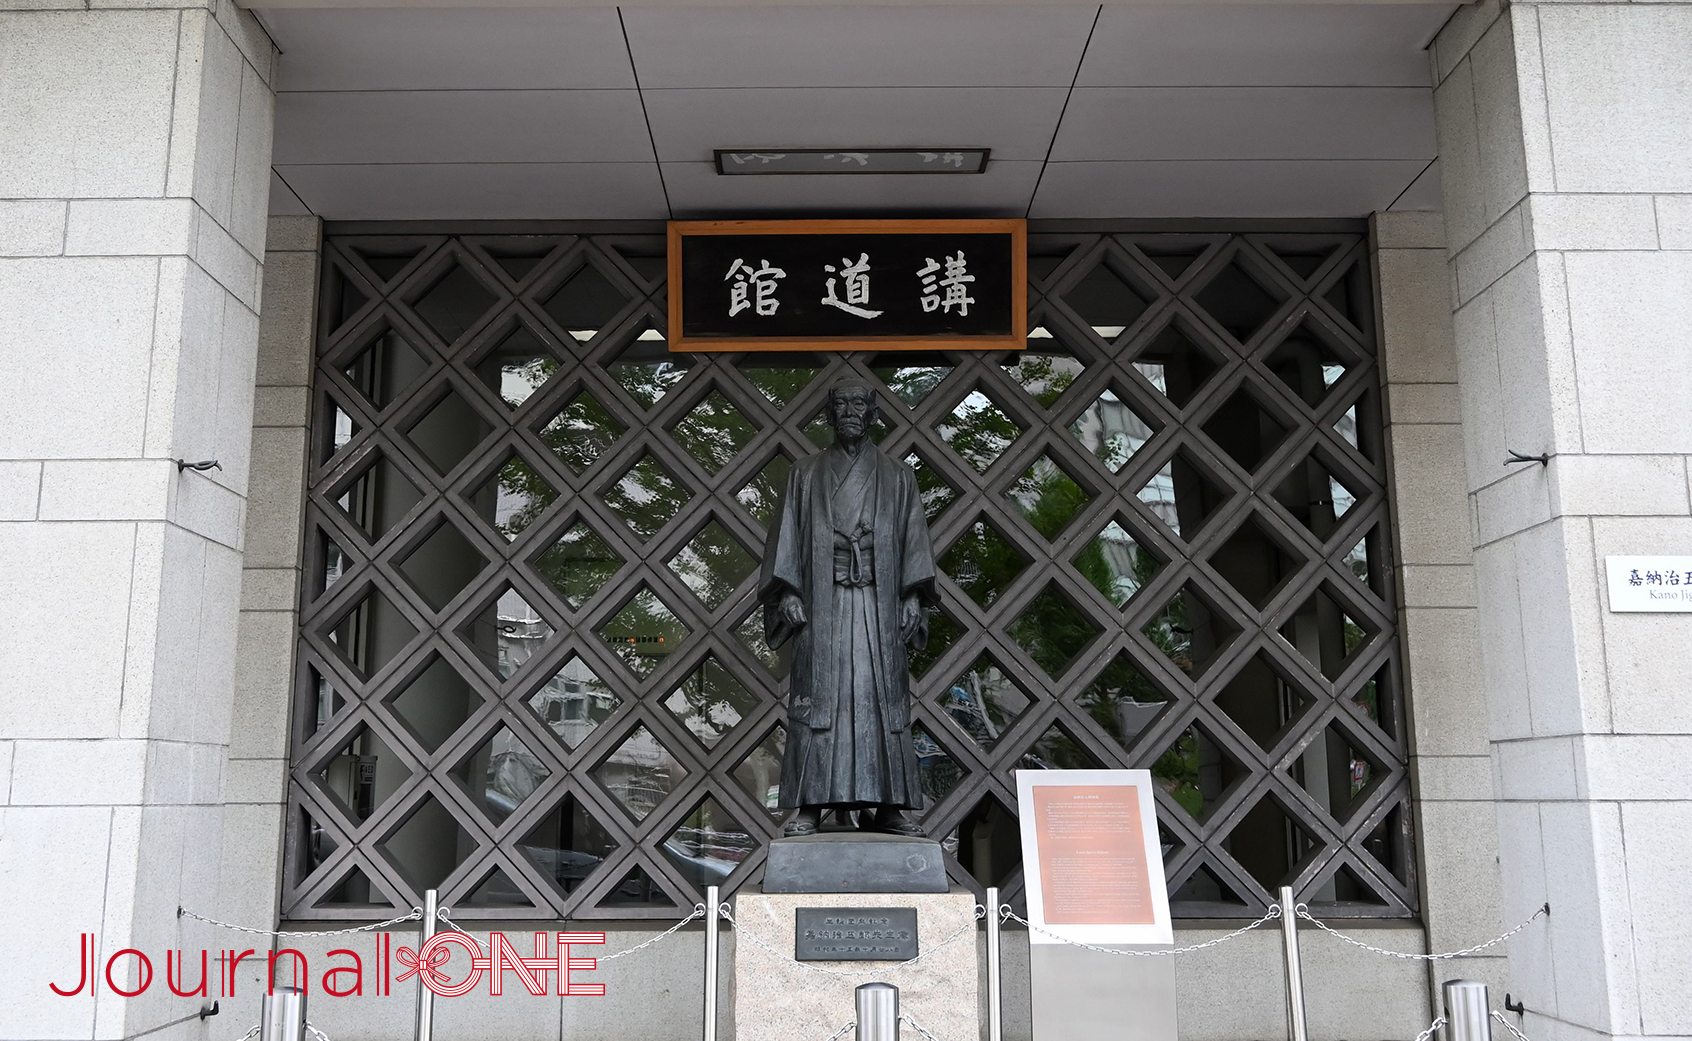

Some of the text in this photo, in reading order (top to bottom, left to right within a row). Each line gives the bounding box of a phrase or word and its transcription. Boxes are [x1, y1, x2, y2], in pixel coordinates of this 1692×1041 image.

[724, 249, 976, 320] 講道館
[1649, 589, 1678, 600] Kano
